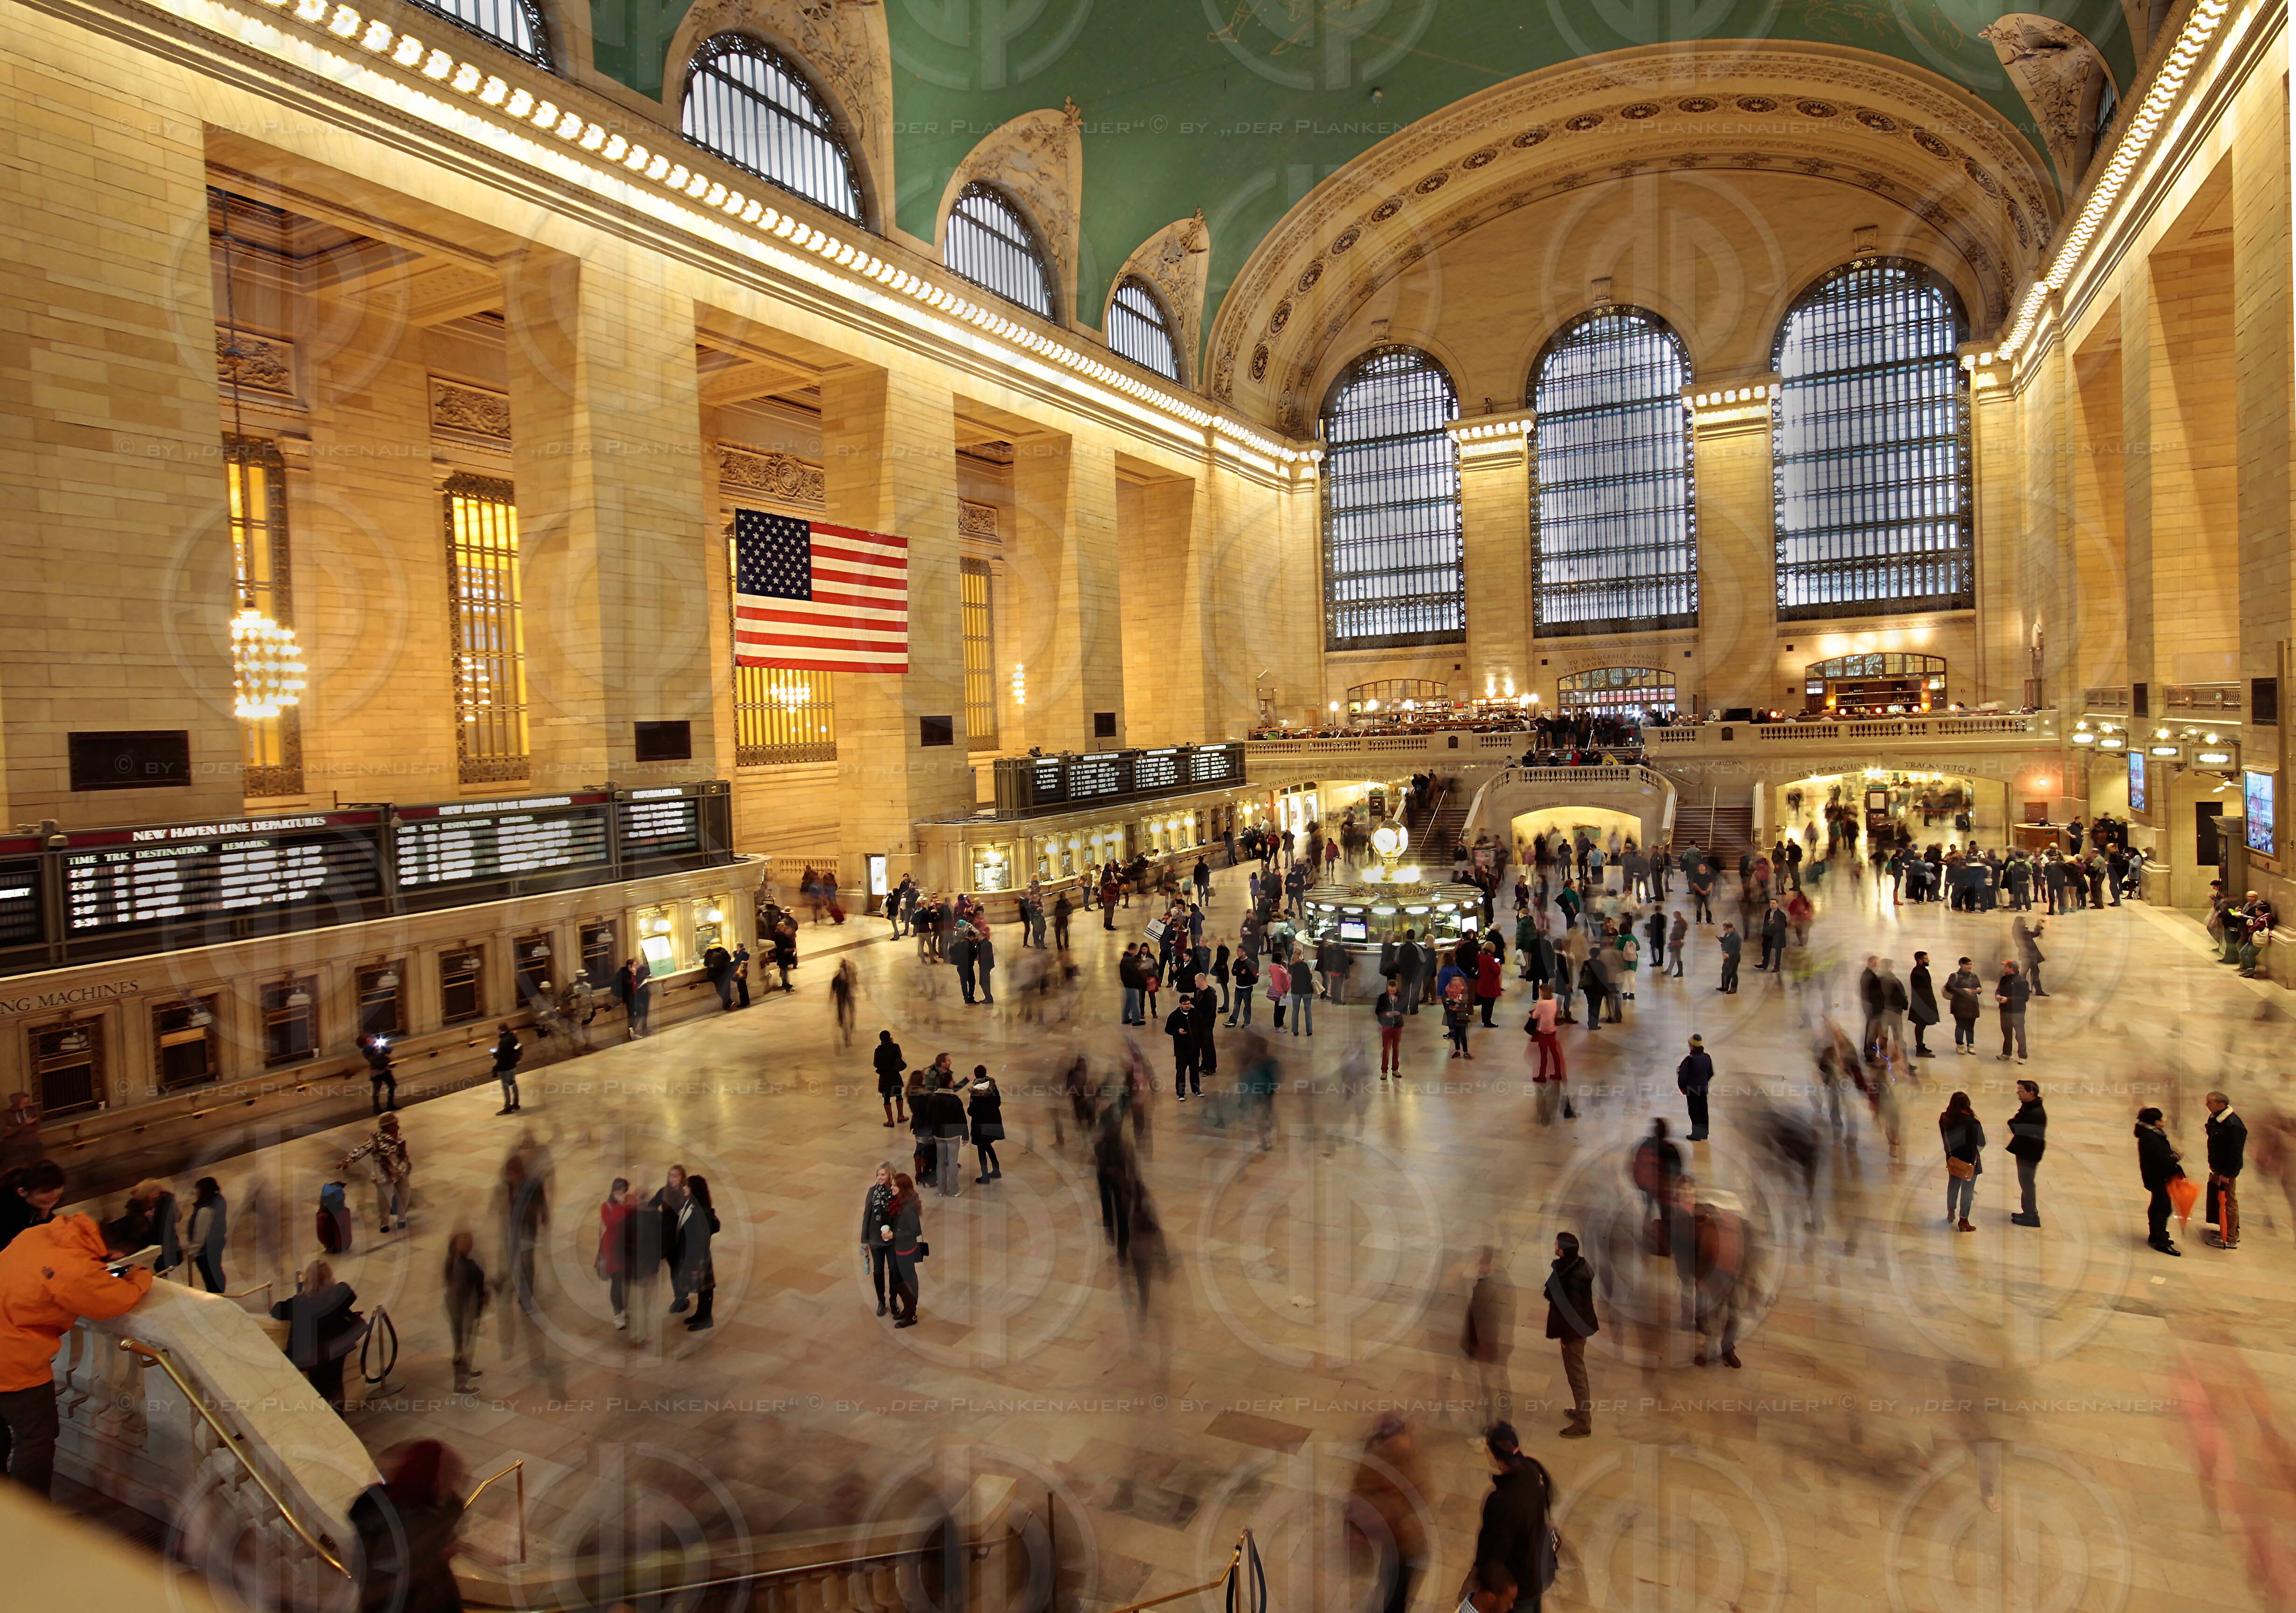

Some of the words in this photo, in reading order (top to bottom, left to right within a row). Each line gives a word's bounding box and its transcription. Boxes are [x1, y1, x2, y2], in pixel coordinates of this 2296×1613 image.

[1829, 762, 1869, 772] MACHINE
[1268, 777, 1291, 787] TICKET
[1292, 773, 1325, 781] MACHINES
[133, 829, 168, 841] NEW
[170, 825, 217, 838] HAVEN
[219, 822, 250, 834] LINE
[252, 817, 327, 831] DEPARTURES
[67, 855, 97, 865] TIME
[105, 852, 131, 862] TRK
[135, 845, 208, 859] DESTINATION
[37, 980, 139, 1009] MACHINES
